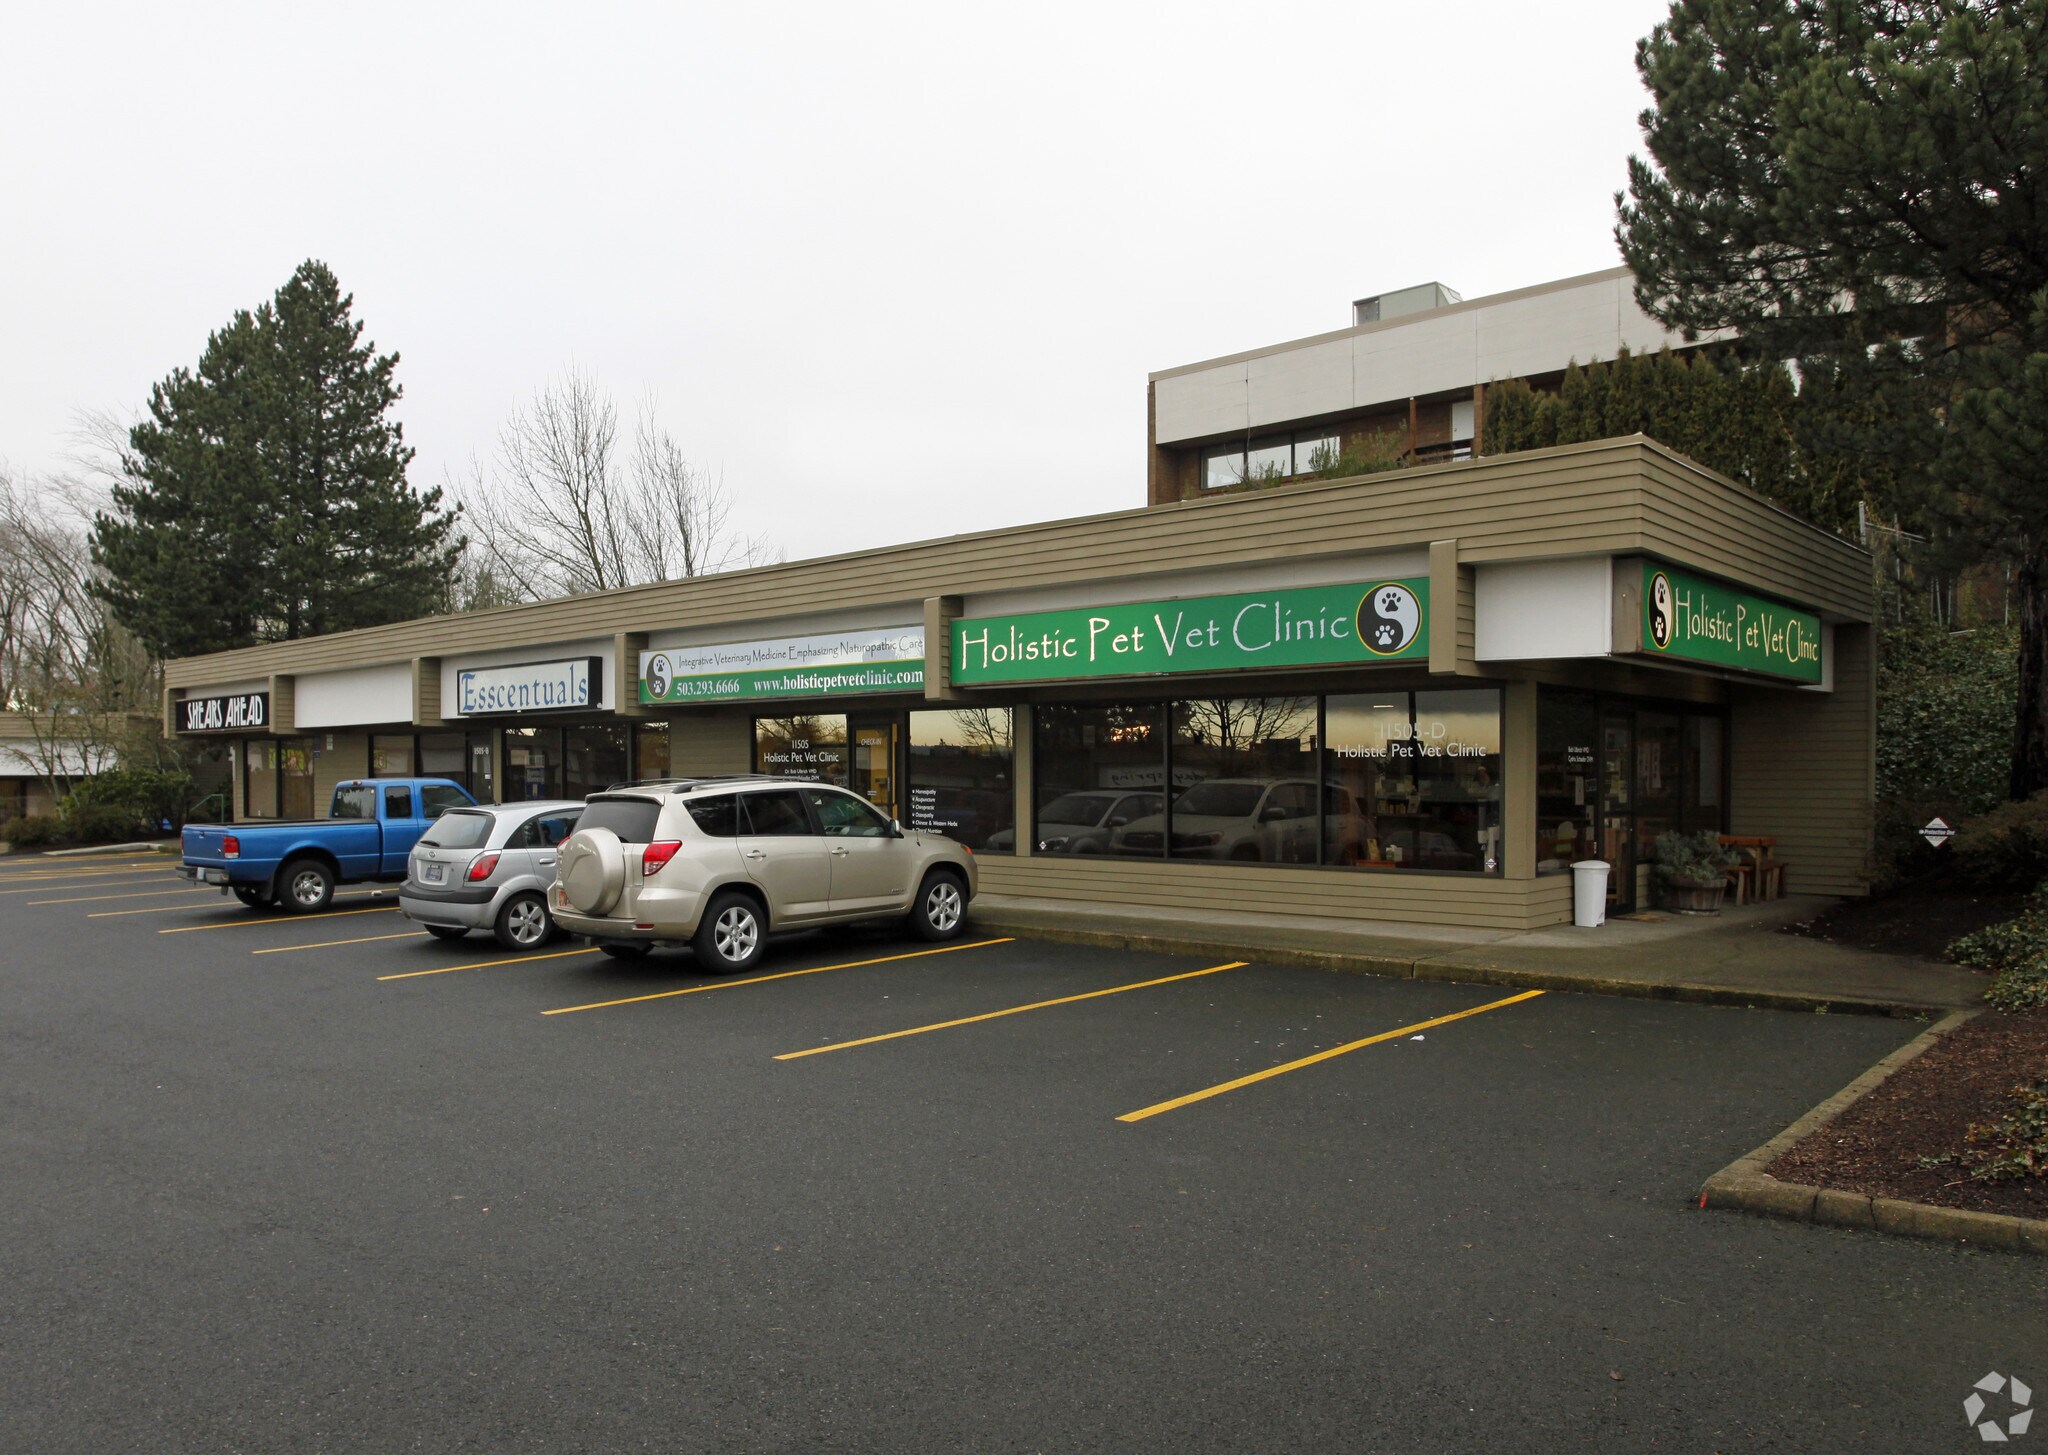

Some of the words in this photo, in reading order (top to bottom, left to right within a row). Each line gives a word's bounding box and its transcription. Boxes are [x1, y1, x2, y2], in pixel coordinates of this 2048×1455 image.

[961, 625, 1078, 671] Holistic
[1088, 617, 1145, 662] Pet
[1154, 611, 1220, 657] Vet
[1232, 600, 1350, 652] Clinic
[1675, 586, 1733, 643] Holistic
[1736, 603, 1759, 651] Pet
[1761, 612, 1784, 657] Vet
[1785, 619, 1818, 663] Clinic
[678, 655, 714, 670] Integrative
[714, 652, 752, 666] Veterinary
[752, 648, 787, 663] Medicine
[788, 645, 839, 662] Emphasizing
[839, 637, 897, 657] Naturopathic
[898, 635, 924, 652] Care
[461, 662, 588, 712] Esscentuals
[676, 678, 740, 697] 503.293.6666
[753, 669, 924, 692] www.holisticpetvetclinic.com
[187, 699, 223, 730] SHEARS
[224, 694, 263, 728] AHEAD
[791, 739, 809, 750] 11505
[1380, 721, 1446, 740] 11505-D
[763, 752, 790, 763] Holistic
[791, 751, 803, 763] Pet
[804, 751, 817, 763] Vet
[818, 751, 839, 763] Clinic
[1337, 744, 1387, 758] Holistic
[1391, 743, 1414, 758] Pet
[1417, 743, 1442, 757] Vet
[1446, 742, 1487, 757] Clinic
